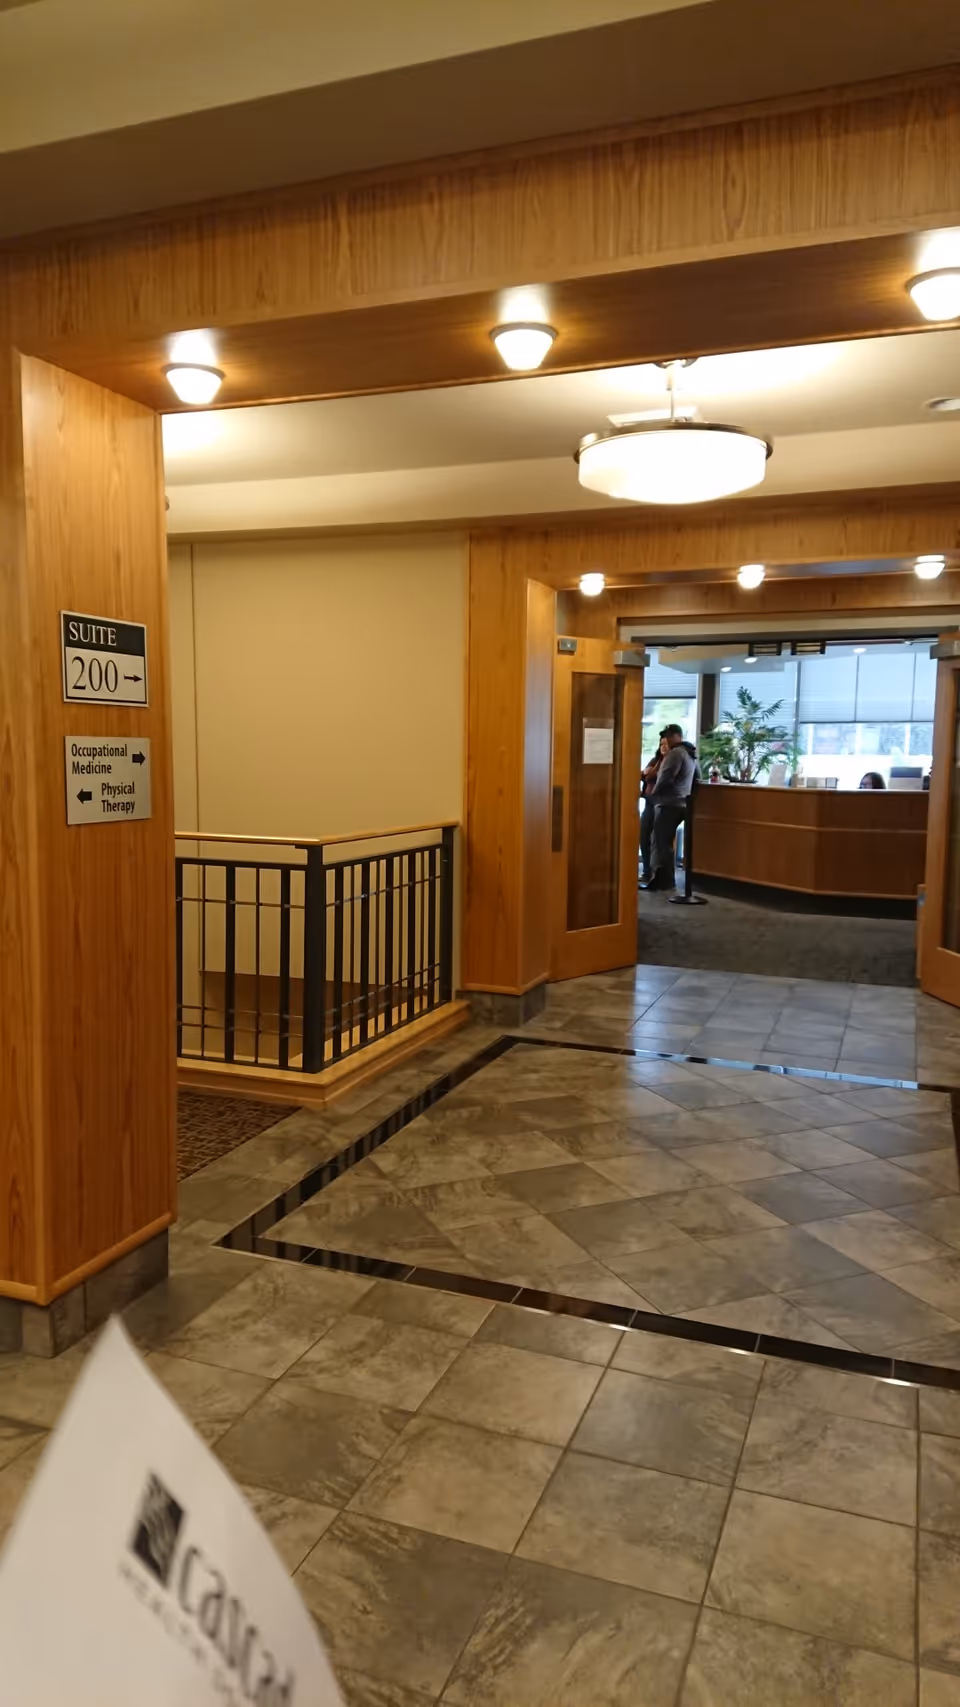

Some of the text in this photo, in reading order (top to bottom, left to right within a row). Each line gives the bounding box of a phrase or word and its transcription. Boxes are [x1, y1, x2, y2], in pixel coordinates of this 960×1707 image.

[68, 621, 117, 646] SUITE
[71, 656, 118, 693] 200
[71, 743, 128, 760] Occupational
[71, 761, 112, 775] Medicine
[101, 782, 135, 797] Physical
[101, 799, 136, 814] Therapy
